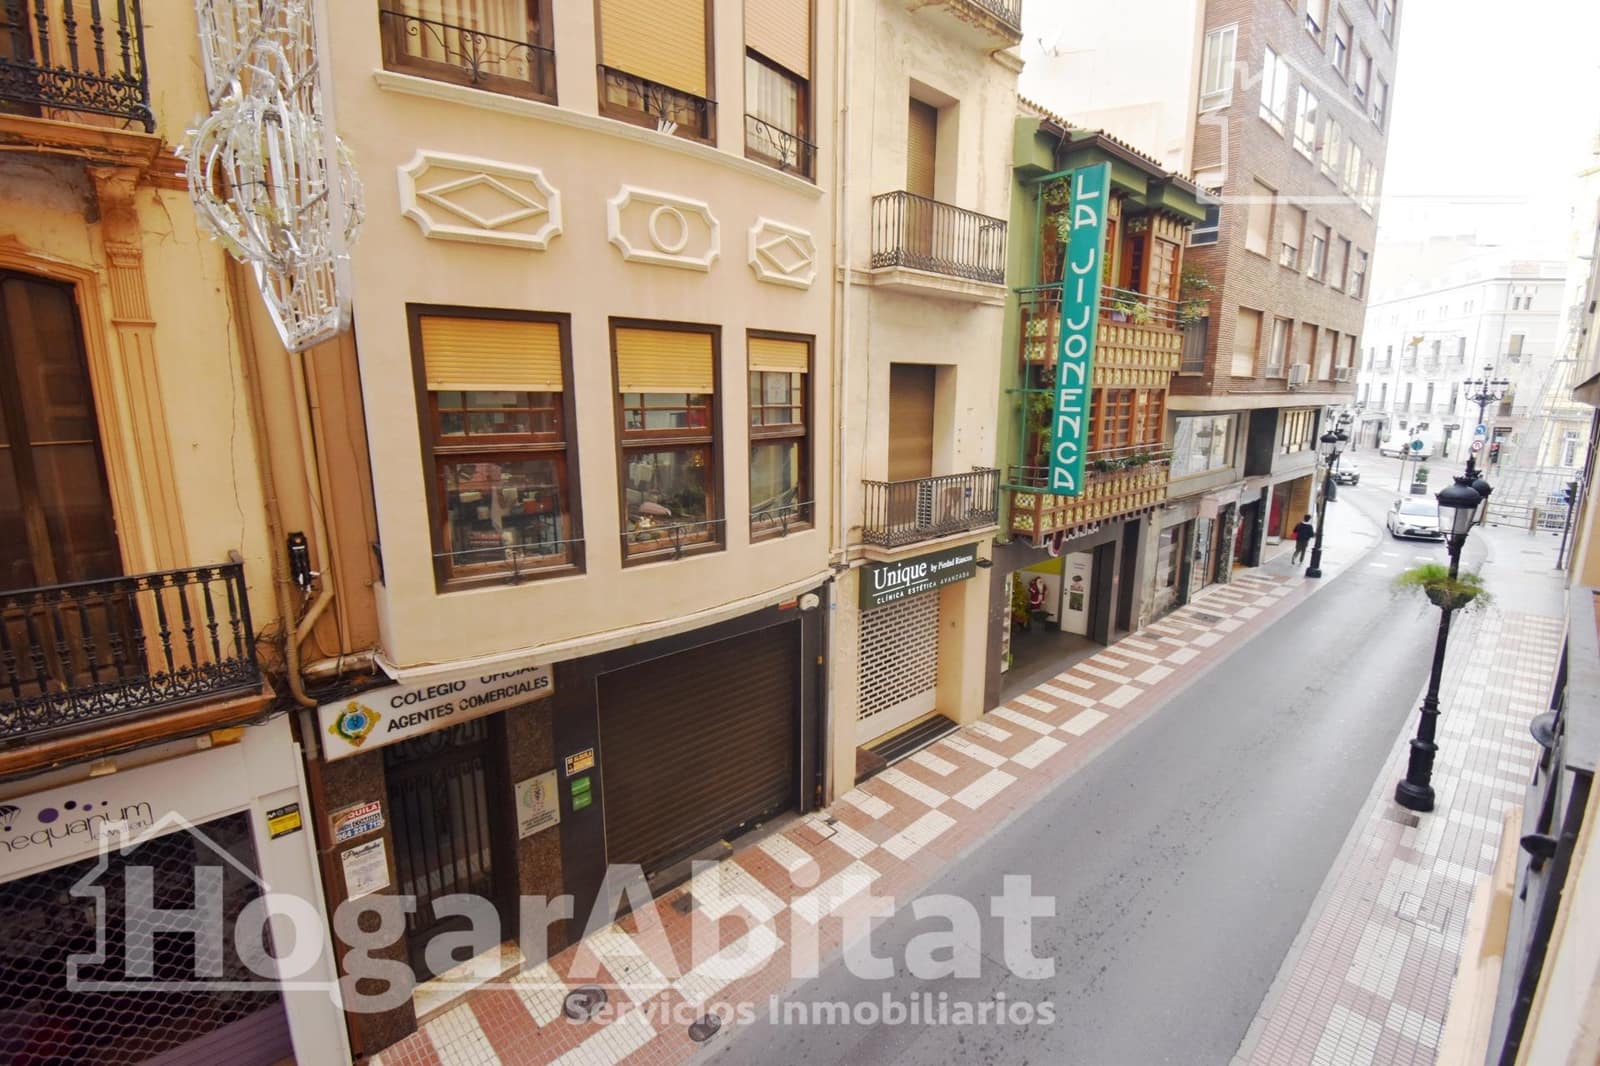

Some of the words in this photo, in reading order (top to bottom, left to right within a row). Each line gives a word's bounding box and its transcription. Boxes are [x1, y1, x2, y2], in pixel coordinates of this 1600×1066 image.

[1074, 175, 1099, 230] LA
[1053, 248, 1095, 491] JIJONENCA
[873, 562, 928, 590] Unique
[876, 591, 904, 604] CLÍNICA
[907, 582, 937, 595] ESTÉTICA
[940, 572, 970, 585] AVANZADA
[387, 703, 454, 733] AGENTES
[459, 676, 549, 711] COMERCIALES
[390, 680, 466, 709] COLEGIO
